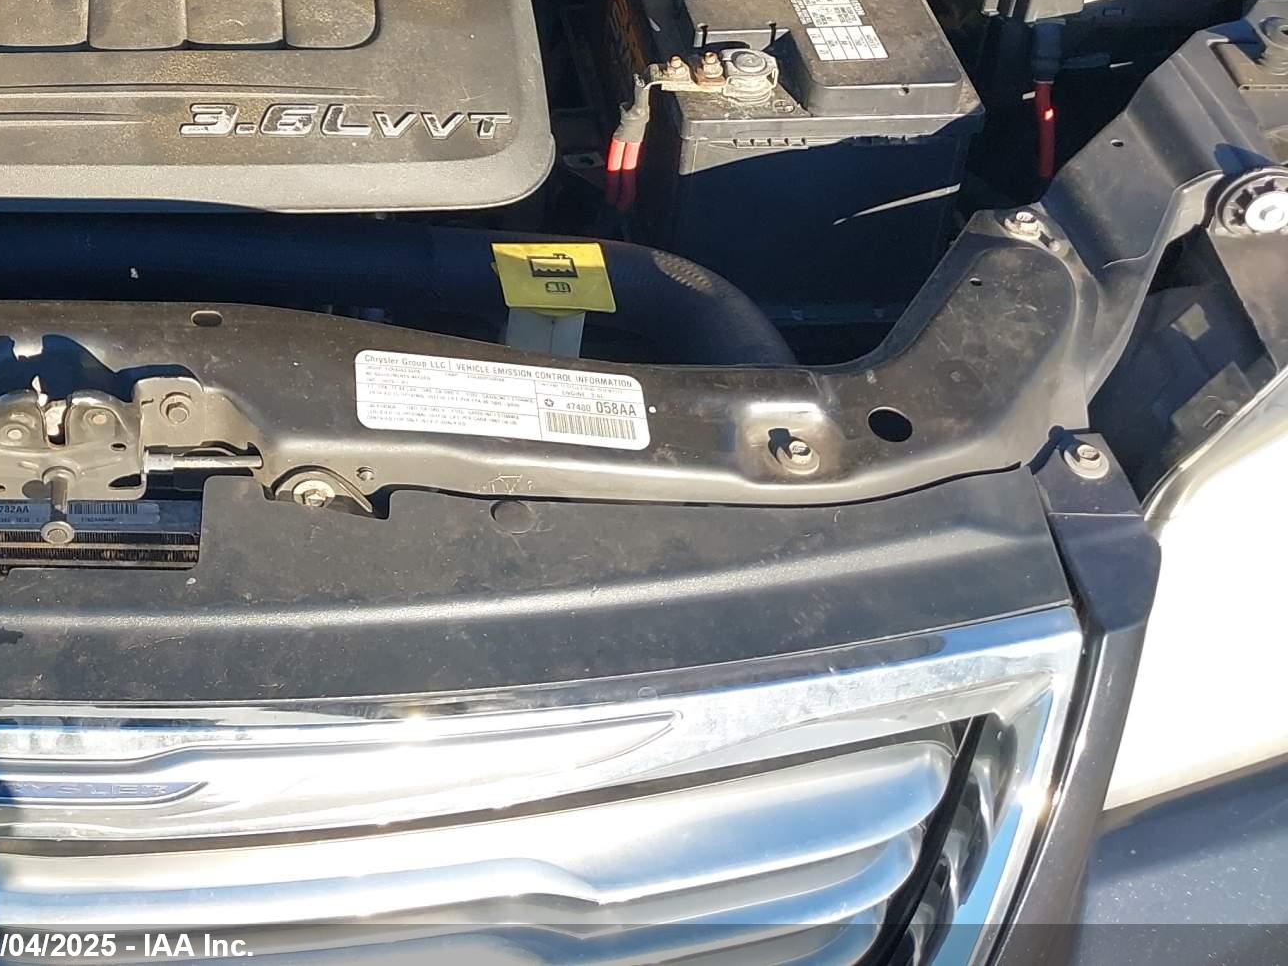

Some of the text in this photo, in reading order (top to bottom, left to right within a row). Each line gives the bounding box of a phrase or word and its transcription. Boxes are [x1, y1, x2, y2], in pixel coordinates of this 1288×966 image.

[364, 354, 399, 367] Chrysler
[402, 357, 428, 369] Group
[430, 358, 447, 369] LLC
[456, 362, 490, 374] VEHICLE
[493, 365, 533, 378] EMISSION
[535, 369, 572, 383] CONTROL
[575, 374, 633, 388] INFORMATION
[596, 401, 637, 416] 058AA
[0, 505, 30, 514] 782AA
